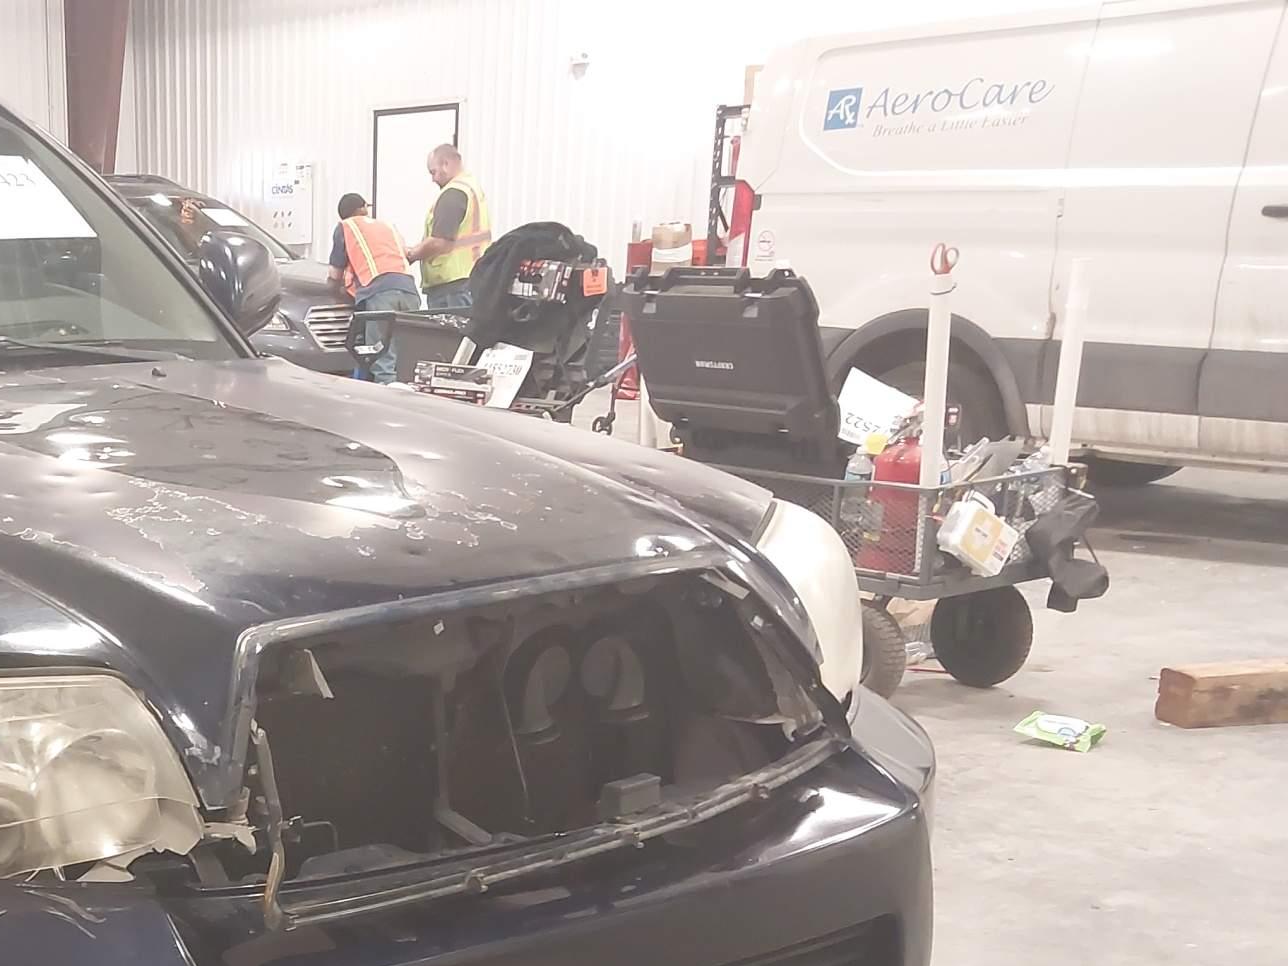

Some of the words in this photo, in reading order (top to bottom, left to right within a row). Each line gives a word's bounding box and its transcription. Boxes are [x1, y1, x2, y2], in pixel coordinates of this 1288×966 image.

[866, 77, 1056, 119] AeroCare
[872, 120, 921, 138] Breathe
[926, 123, 937, 133] a
